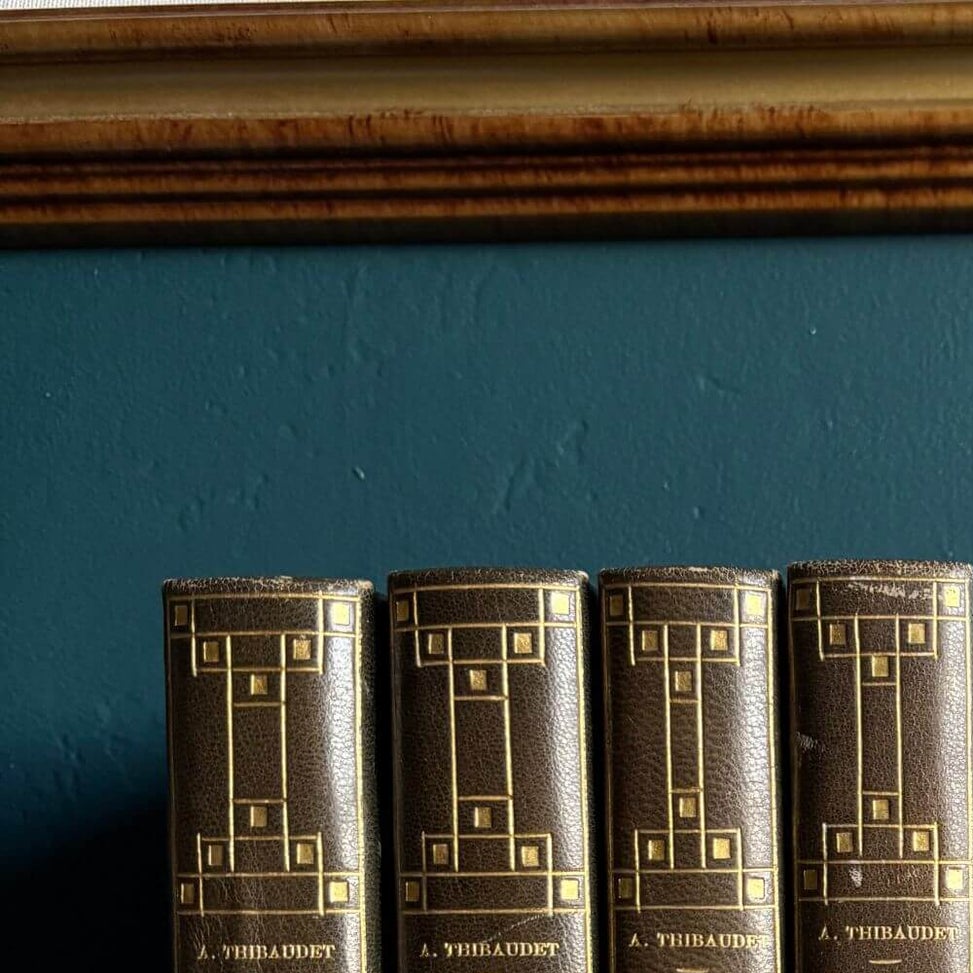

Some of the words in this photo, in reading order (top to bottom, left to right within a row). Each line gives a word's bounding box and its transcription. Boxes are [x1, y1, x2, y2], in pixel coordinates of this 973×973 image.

[628, 933, 649, 948] A.
[657, 932, 771, 948] THIBAUDET
[818, 925, 838, 941] A.
[845, 925, 959, 941] THIBAUDET
[197, 945, 216, 960] A.
[223, 944, 336, 960] THIBAUDET
[419, 943, 438, 958] A.
[444, 942, 560, 958] THIBAUDET
